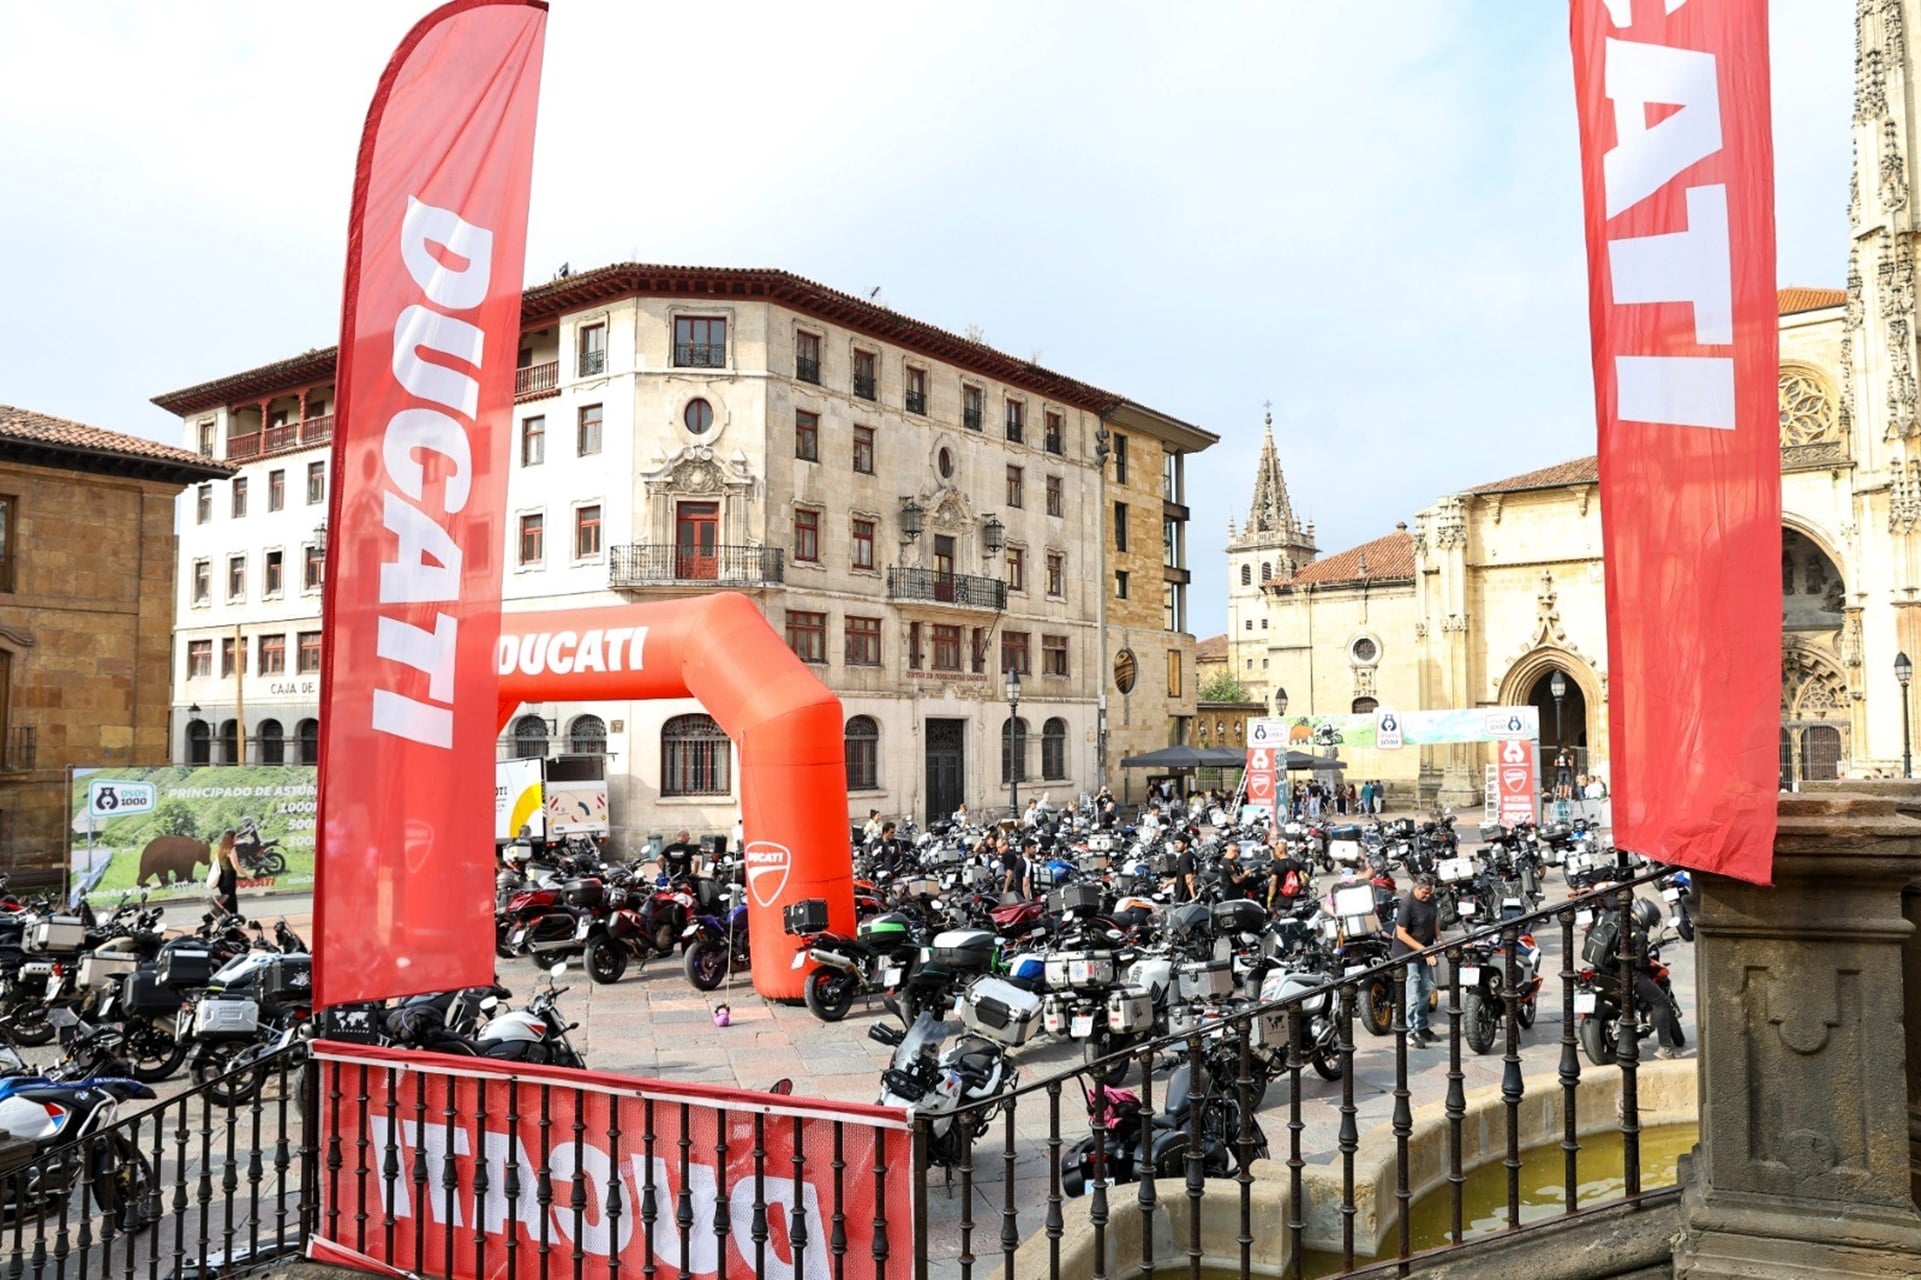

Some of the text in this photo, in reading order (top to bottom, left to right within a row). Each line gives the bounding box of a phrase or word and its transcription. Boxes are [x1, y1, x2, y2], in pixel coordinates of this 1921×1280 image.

[1603, 0, 1736, 431] ATI
[371, 195, 495, 750] DUCATI
[492, 626, 650, 676] DUCATI
[271, 682, 316, 694] CAJA DE
[121, 789, 147, 797] OSOS
[168, 785, 317, 798] PRINCIPADO DE ASTUR
[121, 798, 147, 806] 1000
